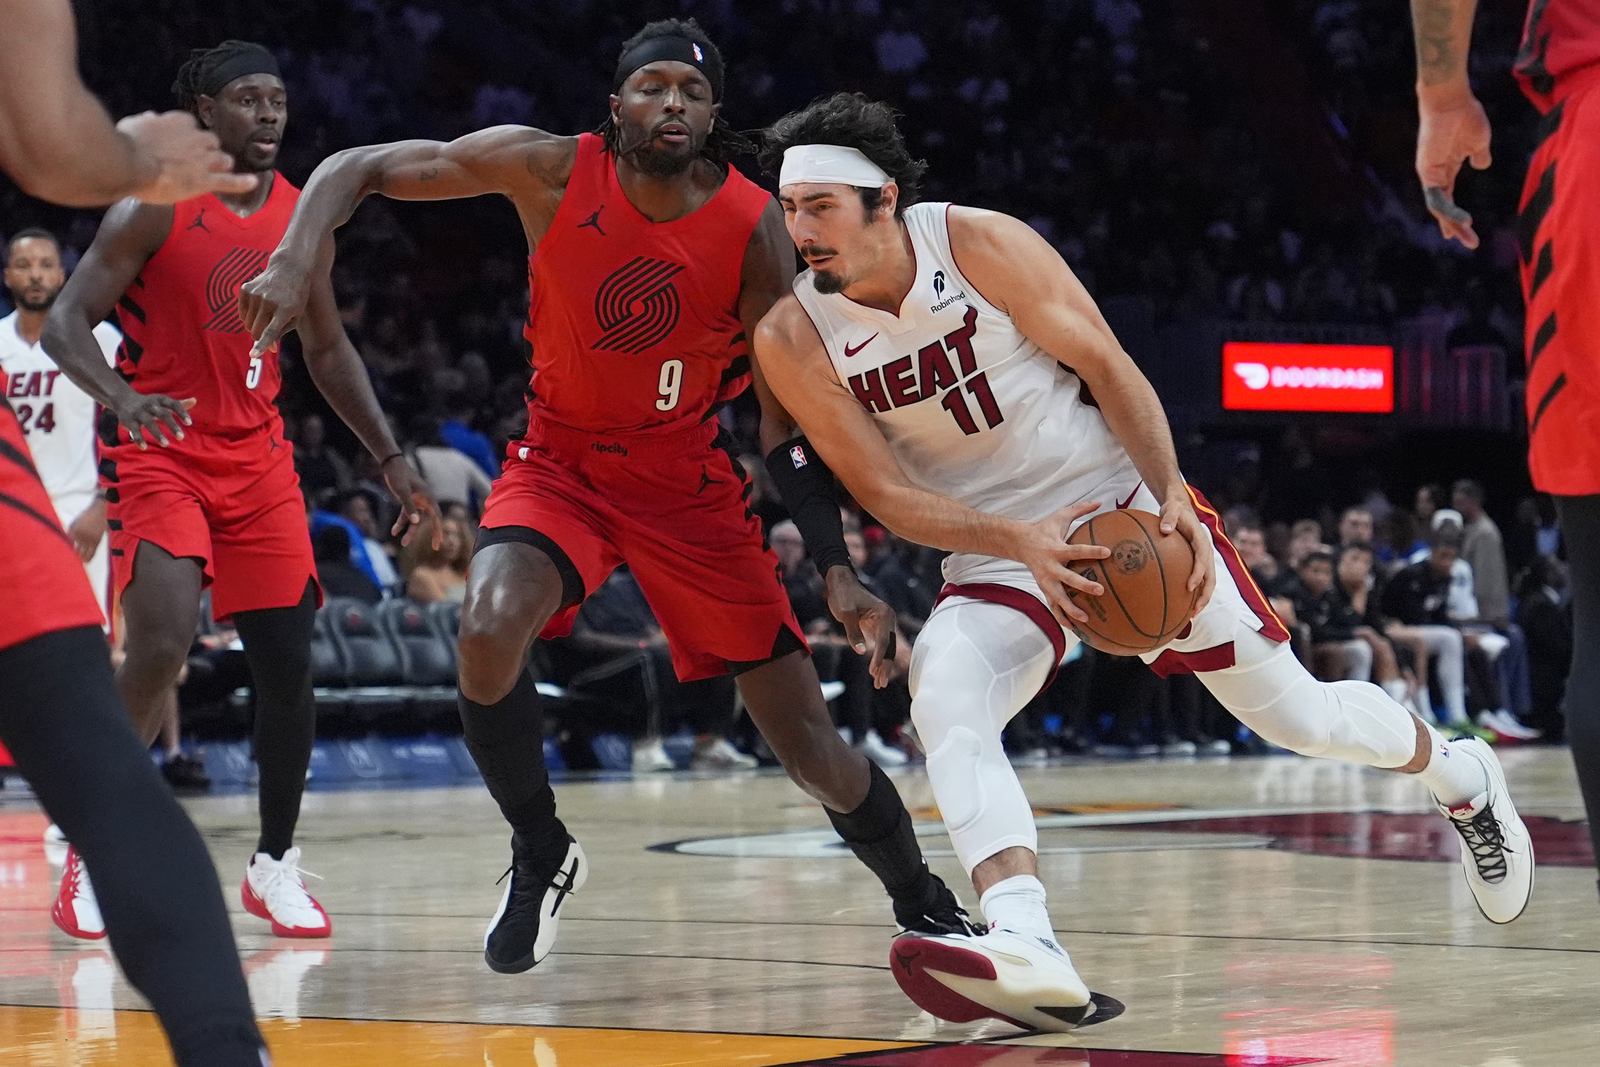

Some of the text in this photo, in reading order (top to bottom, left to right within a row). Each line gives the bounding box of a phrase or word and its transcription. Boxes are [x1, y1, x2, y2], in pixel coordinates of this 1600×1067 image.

[848, 304, 978, 413] HEAT
[7, 370, 61, 397] EAT
[655, 359, 684, 412] 9
[941, 371, 1004, 436] 11
[17, 403, 56, 435] 24
[591, 441, 628, 457] ripcity
